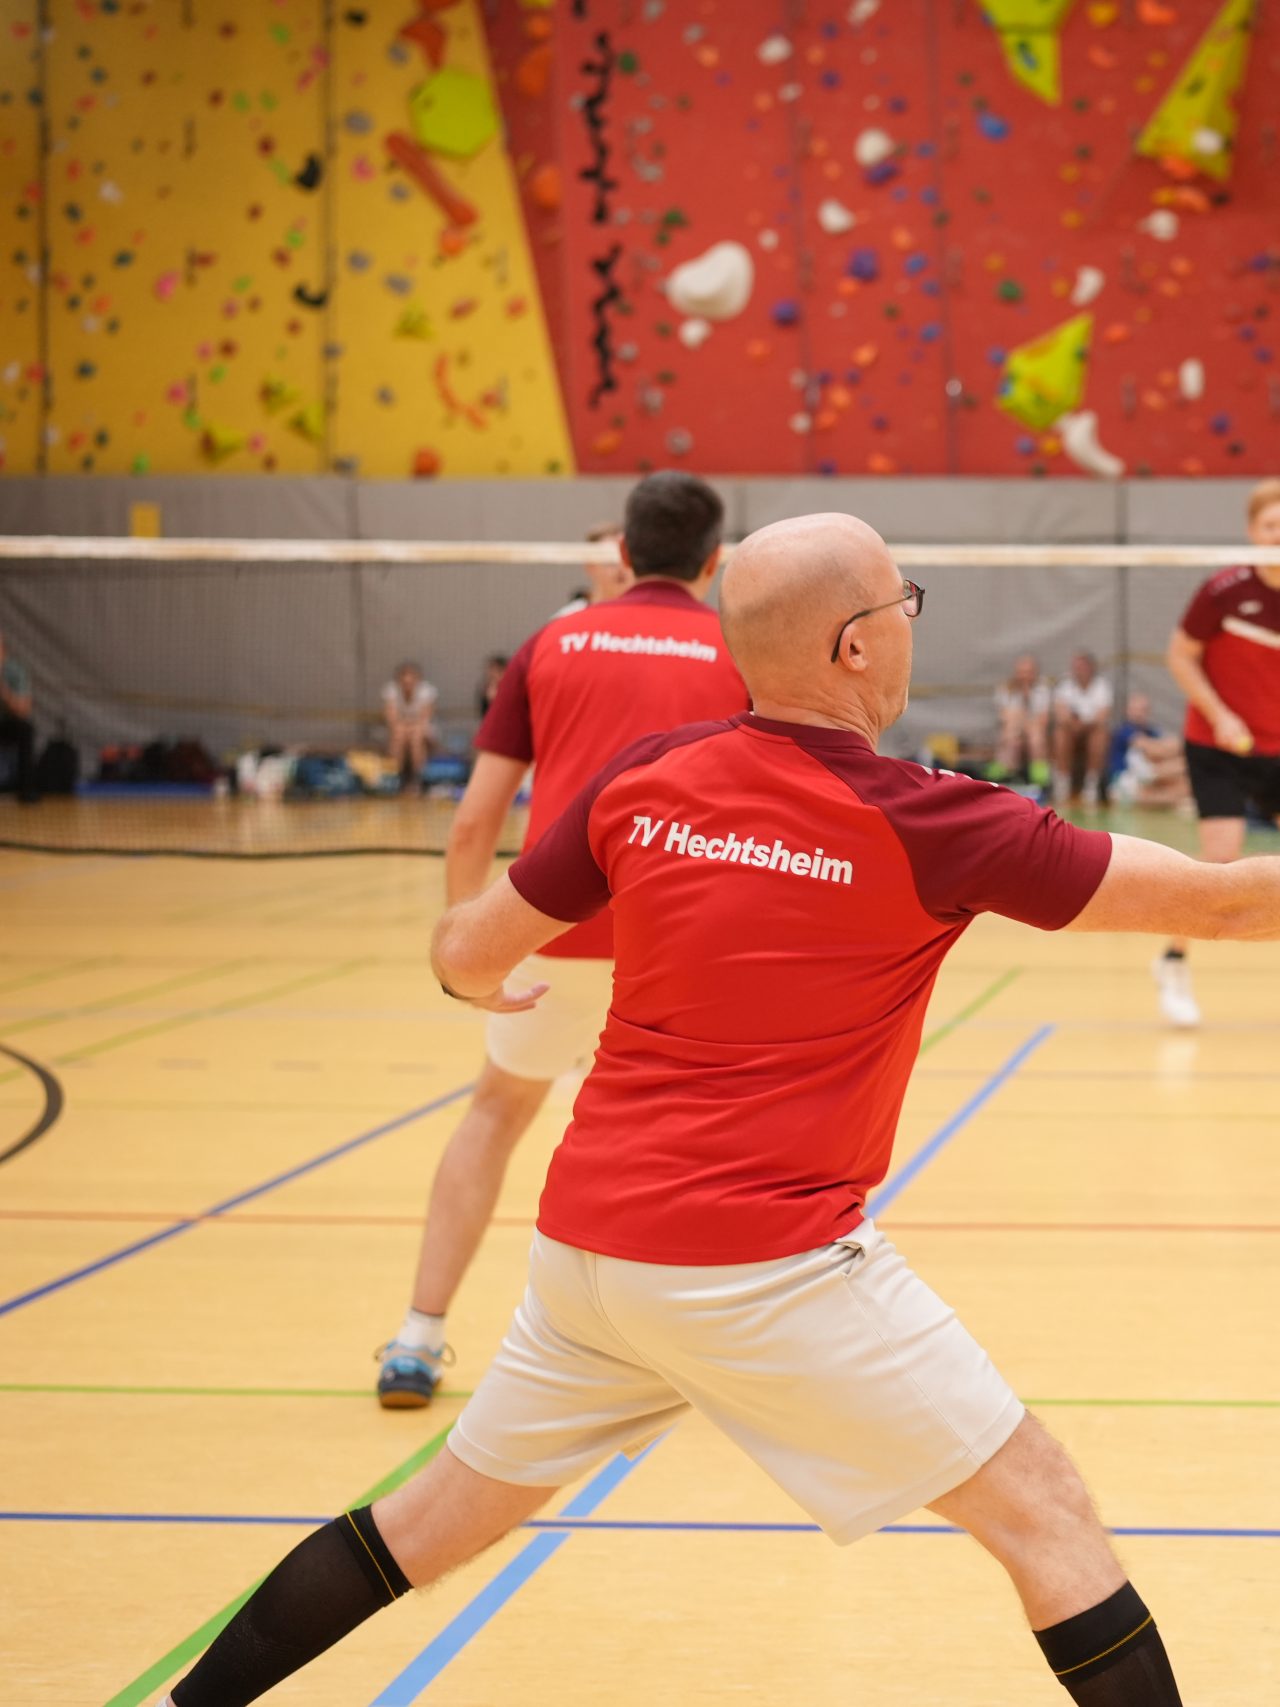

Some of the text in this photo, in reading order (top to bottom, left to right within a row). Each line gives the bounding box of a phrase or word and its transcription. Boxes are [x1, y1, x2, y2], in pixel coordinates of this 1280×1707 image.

[560, 632, 717, 662] TV Hechtsheim
[627, 815, 853, 884] TV Hechtsheim
